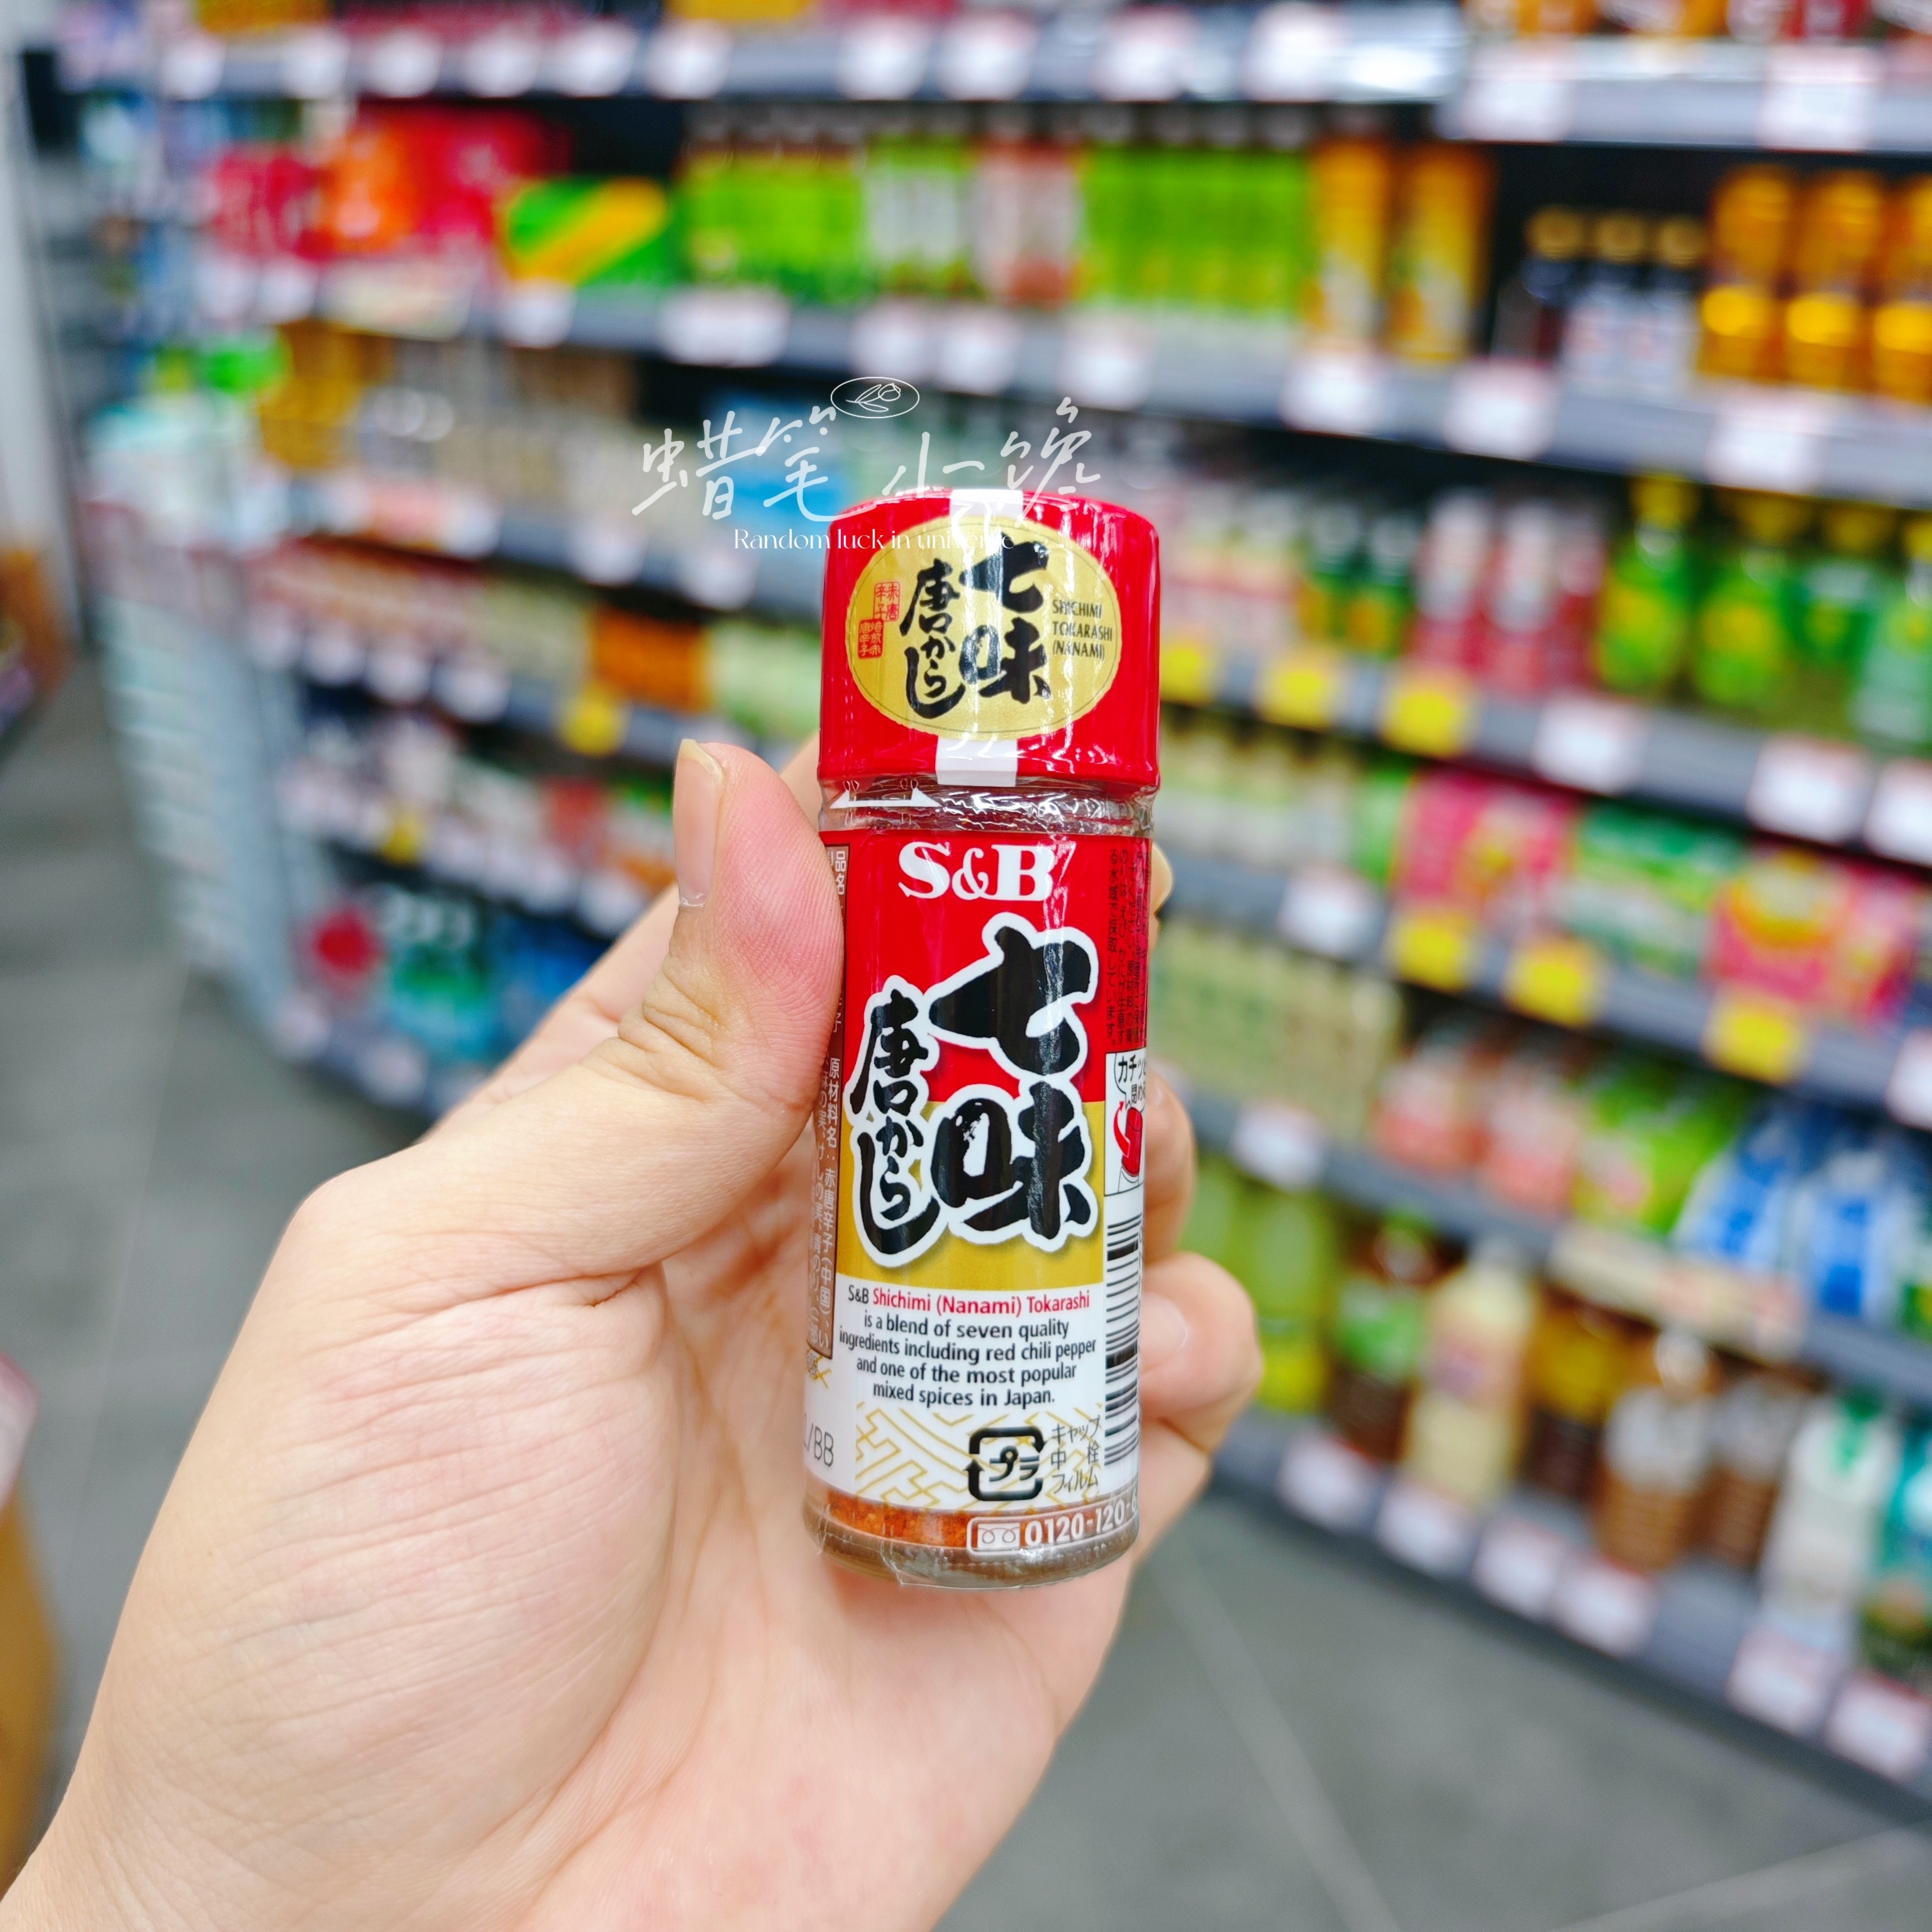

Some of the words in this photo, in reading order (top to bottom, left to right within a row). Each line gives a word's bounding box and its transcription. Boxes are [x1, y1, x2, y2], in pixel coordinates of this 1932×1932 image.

[958, 532, 1052, 704] 七味
[1052, 599, 1102, 619] SHICHIMI
[899, 558, 965, 719] 唐からし
[1052, 621, 1113, 641] TOKARASHI
[1052, 640, 1105, 662] (NANAMI)
[898, 841, 1055, 901] S&B
[928, 924, 1094, 1240] 七味
[849, 988, 941, 1255] 唐からし
[848, 1284, 869, 1304] S&B
[873, 1287, 931, 1312] Shichimi
[936, 1294, 1022, 1318] (Nanami)
[1026, 1289, 1090, 1314] Tokarashi
[864, 1309, 873, 1328] is
[875, 1316, 883, 1330] a
[886, 1312, 929, 1336] blend
[933, 1318, 952, 1337] of
[957, 1324, 1013, 1338] seven
[1018, 1318, 1070, 1342] quality
[840, 1324, 900, 1355] ingredients
[904, 1337, 980, 1365] including
[985, 1342, 1016, 1362] red
[1021, 1340, 1052, 1360] chili
[1055, 1339, 1097, 1363] pepper
[856, 1355, 877, 1374] and
[880, 1362, 906, 1378] one
[909, 1362, 927, 1380] of
[931, 1363, 960, 1382] the
[966, 1367, 1016, 1384] most
[1020, 1361, 1077, 1388] popular
[872, 1380, 914, 1402] mixed
[918, 1386, 974, 1408] spices
[980, 1388, 998, 1406] in
[1003, 1388, 1055, 1410] Japan.
[1051, 1414, 1101, 1445] キャップ
[989, 1445, 1040, 1482] プラ
[1051, 1466, 1099, 1494] フィルム
